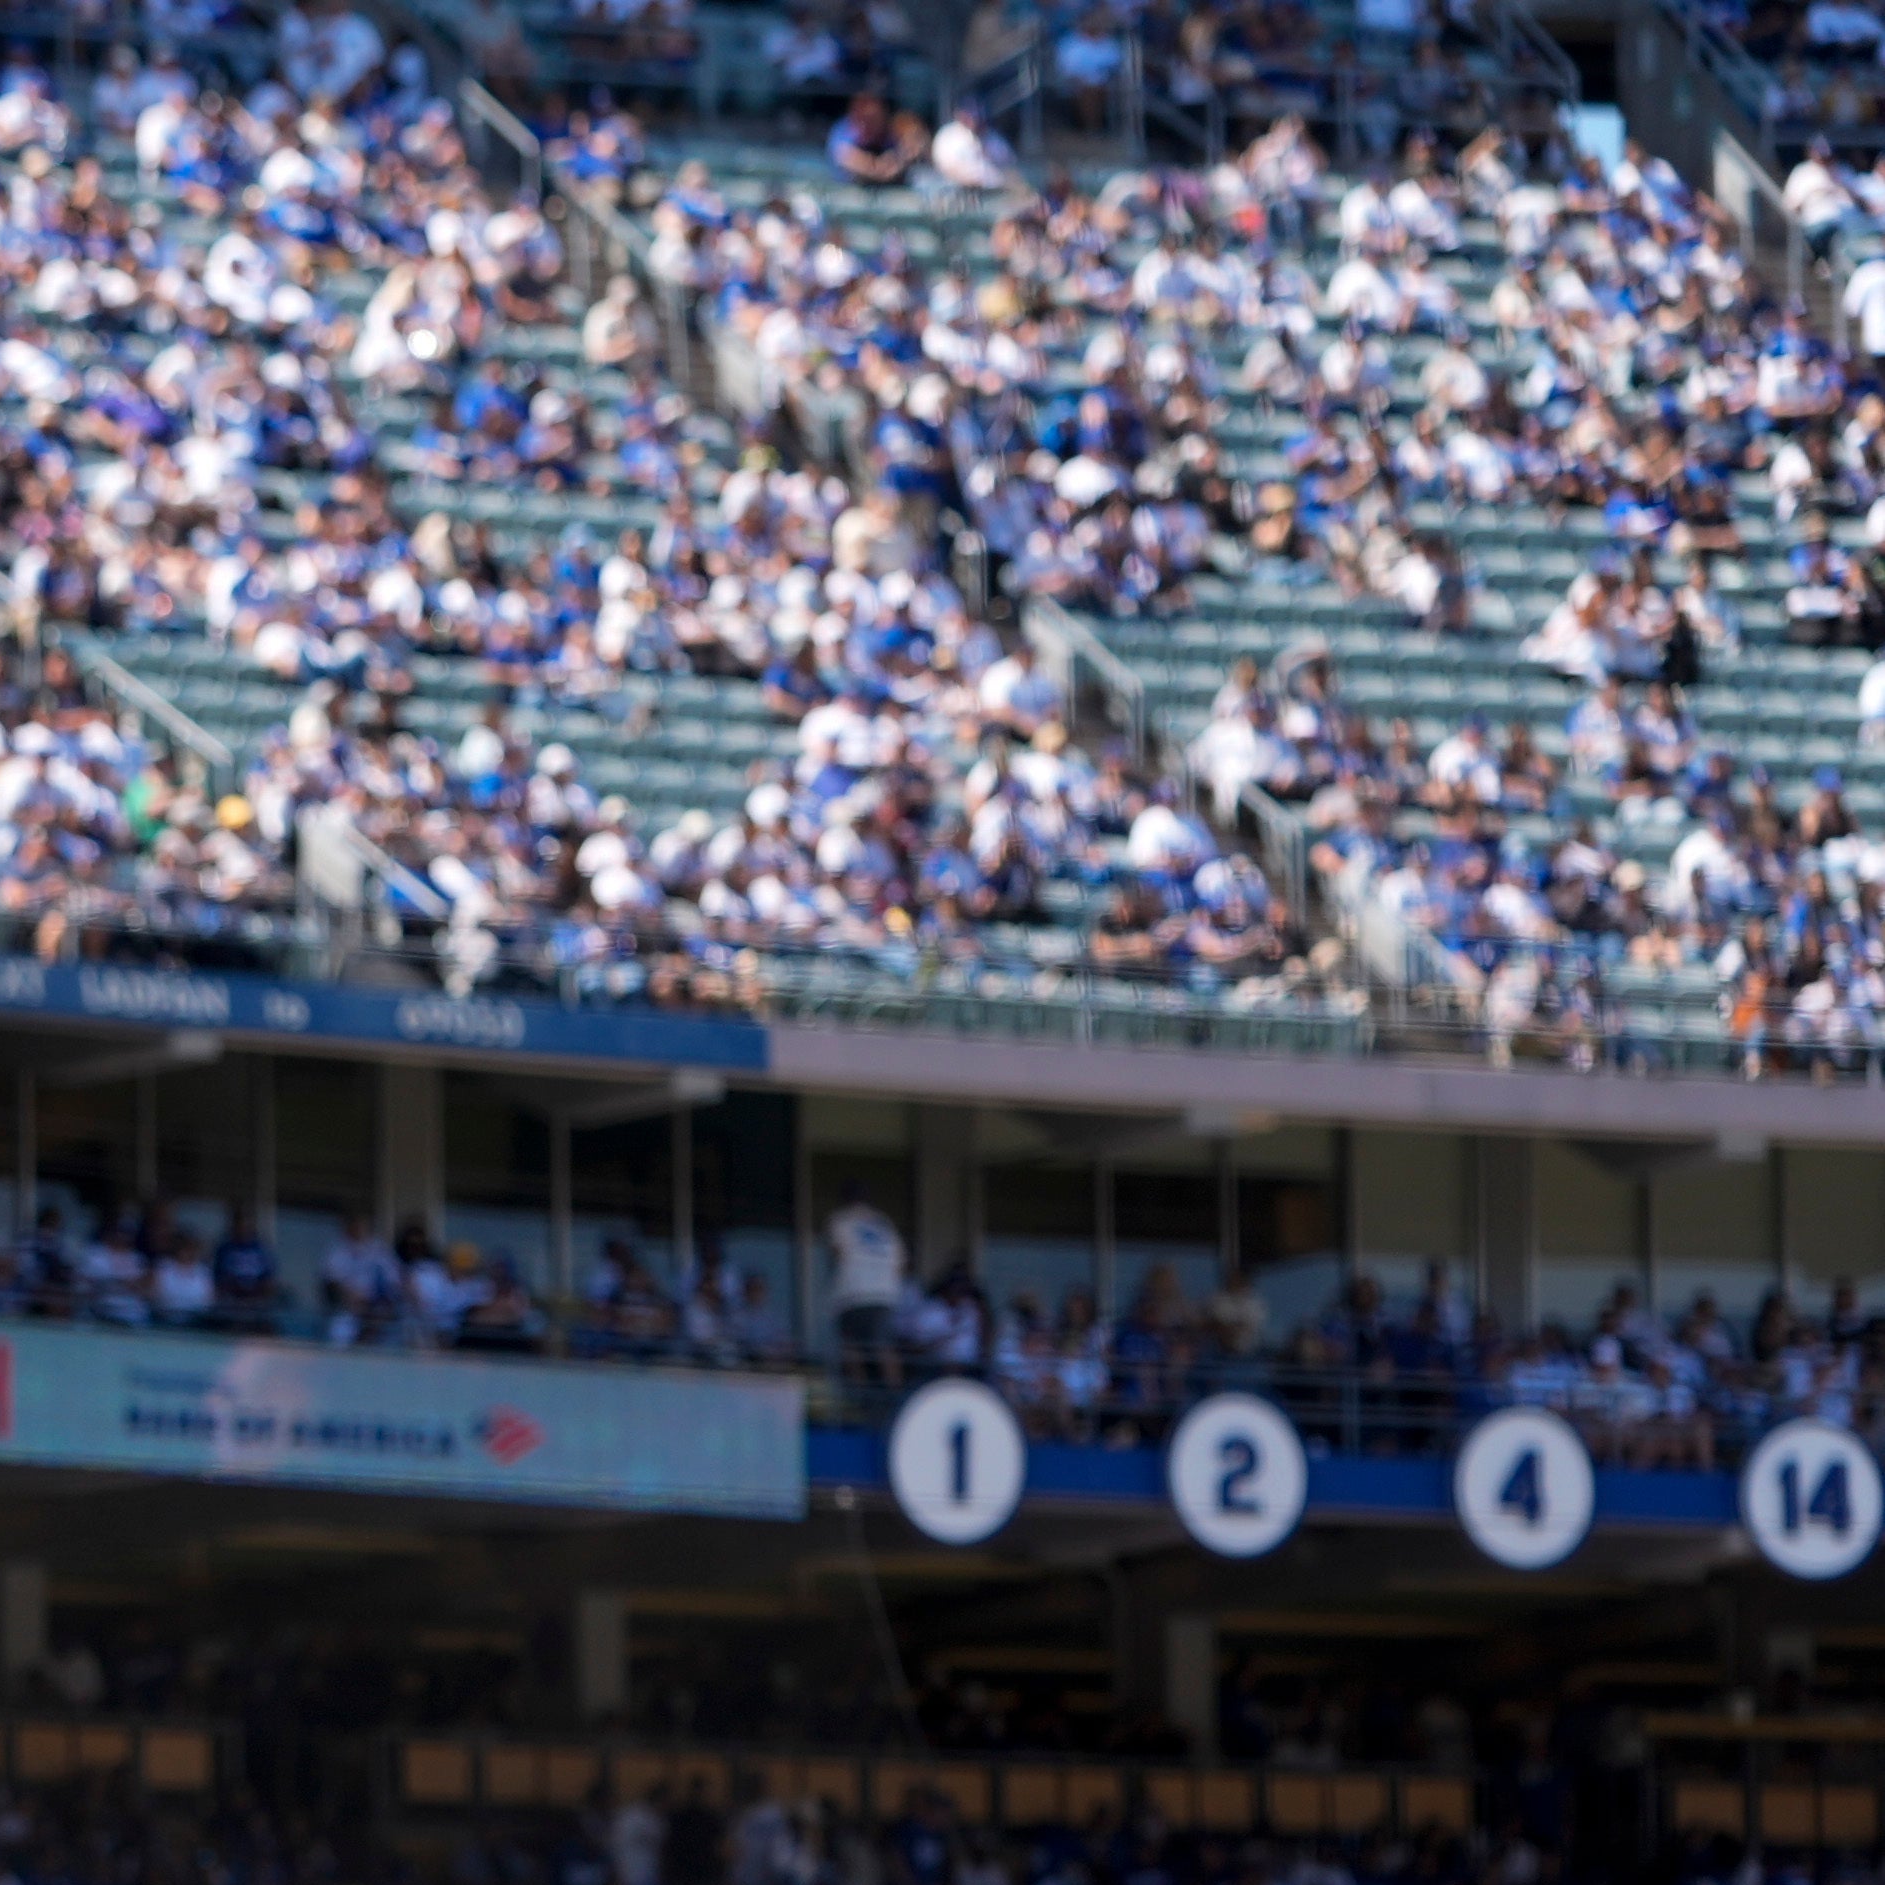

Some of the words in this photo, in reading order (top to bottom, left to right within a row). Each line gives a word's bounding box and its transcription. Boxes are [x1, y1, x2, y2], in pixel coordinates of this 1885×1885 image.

[946, 1420, 970, 1506] 1
[1217, 1433, 1263, 1516] 2
[1498, 1440, 1546, 1530] 4
[1777, 1455, 1854, 1540] 14
